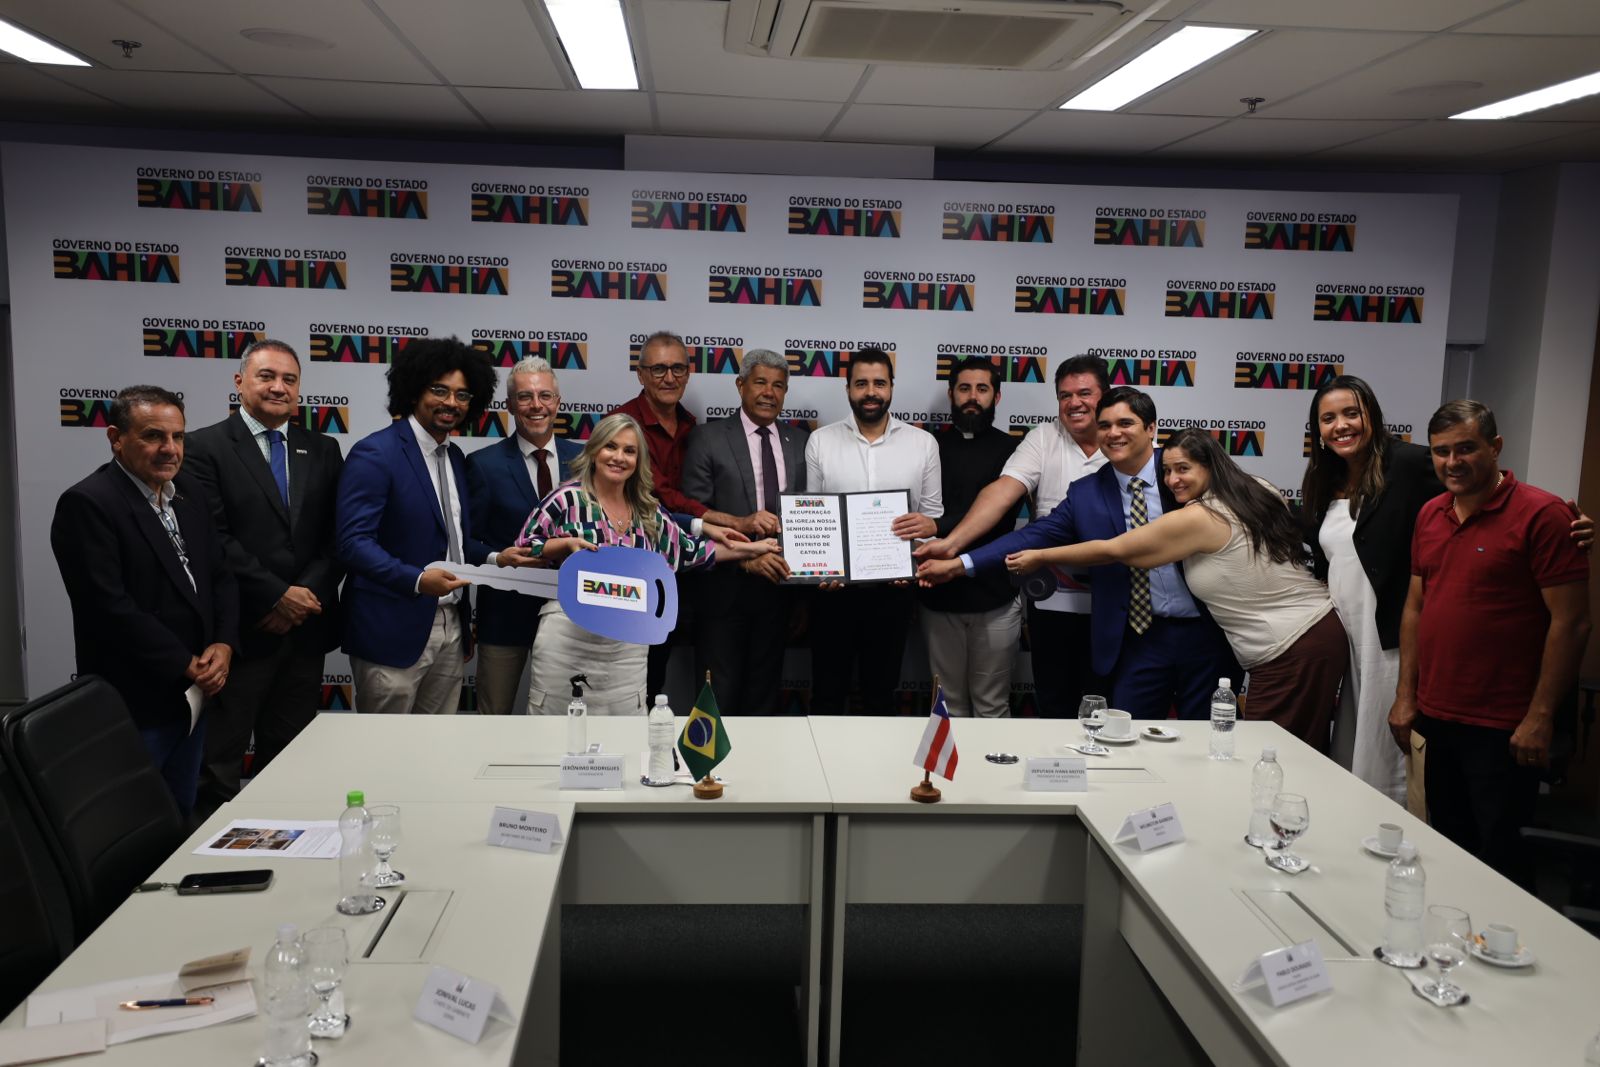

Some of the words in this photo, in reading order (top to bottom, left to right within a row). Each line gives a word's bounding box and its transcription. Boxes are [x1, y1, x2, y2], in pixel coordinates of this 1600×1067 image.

[137, 167, 194, 179] GOVERNO
[198, 170, 214, 180] DO
[218, 171, 262, 182] ESTADO
[307, 176, 362, 186] GOVERNO
[366, 178, 382, 187] DO
[386, 179, 427, 190] ESTADO
[472, 183, 526, 194] GOVERNO
[530, 186, 544, 194] DO
[548, 186, 588, 196] ESTADO
[136, 178, 262, 212] BAHIA
[632, 190, 685, 200] GOVERNO
[689, 192, 703, 201] DO
[707, 193, 747, 203] ESTADO
[307, 187, 428, 220] BAHIA
[789, 196, 841, 207] GOVERNO
[845, 199, 859, 208] DO
[863, 200, 902, 209] ESTADO
[944, 202, 994, 212] GOVERNO
[998, 204, 1012, 213] DO
[1016, 205, 1055, 214] ESTADO
[471, 194, 589, 226] BAHIA
[632, 201, 747, 232] BAHIA
[1096, 208, 1146, 217] GOVERNO
[1150, 209, 1164, 217] DO
[1168, 210, 1206, 218] ESTADO
[788, 207, 902, 238] BAHIA
[1247, 212, 1297, 222] GOVERNO
[1300, 213, 1315, 222] DO
[1318, 214, 1356, 223] ESTADO
[943, 212, 1055, 243] BAHIA
[1094, 218, 1206, 248] BAHIA
[1245, 222, 1356, 252] BAHIA
[53, 239, 111, 250] GOVERNO
[115, 242, 131, 252] DO
[135, 243, 178, 253] ESTADO
[225, 247, 281, 257] GOVERNO
[285, 249, 300, 258] DO
[304, 250, 346, 260] ESTADO
[391, 253, 445, 264] GOVERNO
[449, 256, 464, 264] DO
[468, 256, 508, 266] ESTADO
[53, 249, 180, 284] BAHIA
[552, 259, 605, 270] GOVERNO
[609, 262, 623, 270] DO
[627, 262, 667, 272] ESTADO
[710, 265, 761, 275] GOVERNO
[765, 268, 779, 276] DO
[783, 268, 822, 278] ESTADO
[224, 257, 347, 290] BAHIA
[390, 263, 509, 295] BAHIA
[864, 271, 915, 280] GOVERNO
[919, 273, 933, 281] DO
[936, 273, 975, 283] ESTADO
[551, 270, 667, 301] BAHIA
[1016, 276, 1067, 285] GOVERNO
[1070, 278, 1084, 286] DO
[1088, 278, 1126, 287] ESTADO
[1167, 280, 1217, 290] GOVERNO
[1220, 282, 1234, 290] DO
[1238, 282, 1276, 292] ESTADO
[709, 276, 822, 307] BAHIA
[1316, 284, 1366, 294] GOVERNO
[1369, 286, 1383, 294] DO
[1387, 286, 1424, 295] ESTADO
[863, 281, 975, 312] BAHIA
[1015, 286, 1126, 316] BAHIA
[1165, 290, 1276, 320] BAHIA
[1314, 294, 1424, 323] BAHIA
[143, 318, 199, 328] GOVERNO
[203, 320, 219, 329] DO
[223, 321, 265, 331] ESTADO
[310, 324, 364, 334] GOVERNO
[368, 326, 384, 334] DO
[388, 326, 428, 336] ESTADO
[472, 329, 525, 339] GOVERNO
[529, 331, 544, 340] DO
[548, 332, 587, 341] ESTADO
[686, 336, 700, 345] DO
[704, 337, 743, 346] ESTADO
[785, 339, 836, 349] GOVERNO
[840, 341, 854, 350] DO
[938, 344, 988, 353] GOVERNO
[991, 346, 1006, 354] DO
[1009, 346, 1047, 355] ESTADO
[1088, 348, 1137, 358] GOVERNO
[1141, 350, 1155, 358] DO
[1158, 350, 1196, 359] ESTADO
[1237, 352, 1286, 361] GOVERNO
[1290, 353, 1303, 362] DO
[1307, 354, 1344, 363] ESTADO
[1106, 359, 1195, 386] AHIA
[60, 388, 117, 399] GOVERNO
[307, 396, 348, 405] ESTADO
[560, 402, 603, 412] OVERNO
[707, 407, 737, 416] GOVE
[780, 409, 818, 418] ESTADO
[1158, 419, 1207, 428] GOVERNO
[1211, 420, 1225, 428] DO
[1228, 420, 1266, 430] ESTADO
[584, 580, 640, 599] BAHIA
[519, 825, 547, 833] MONTEIRO
